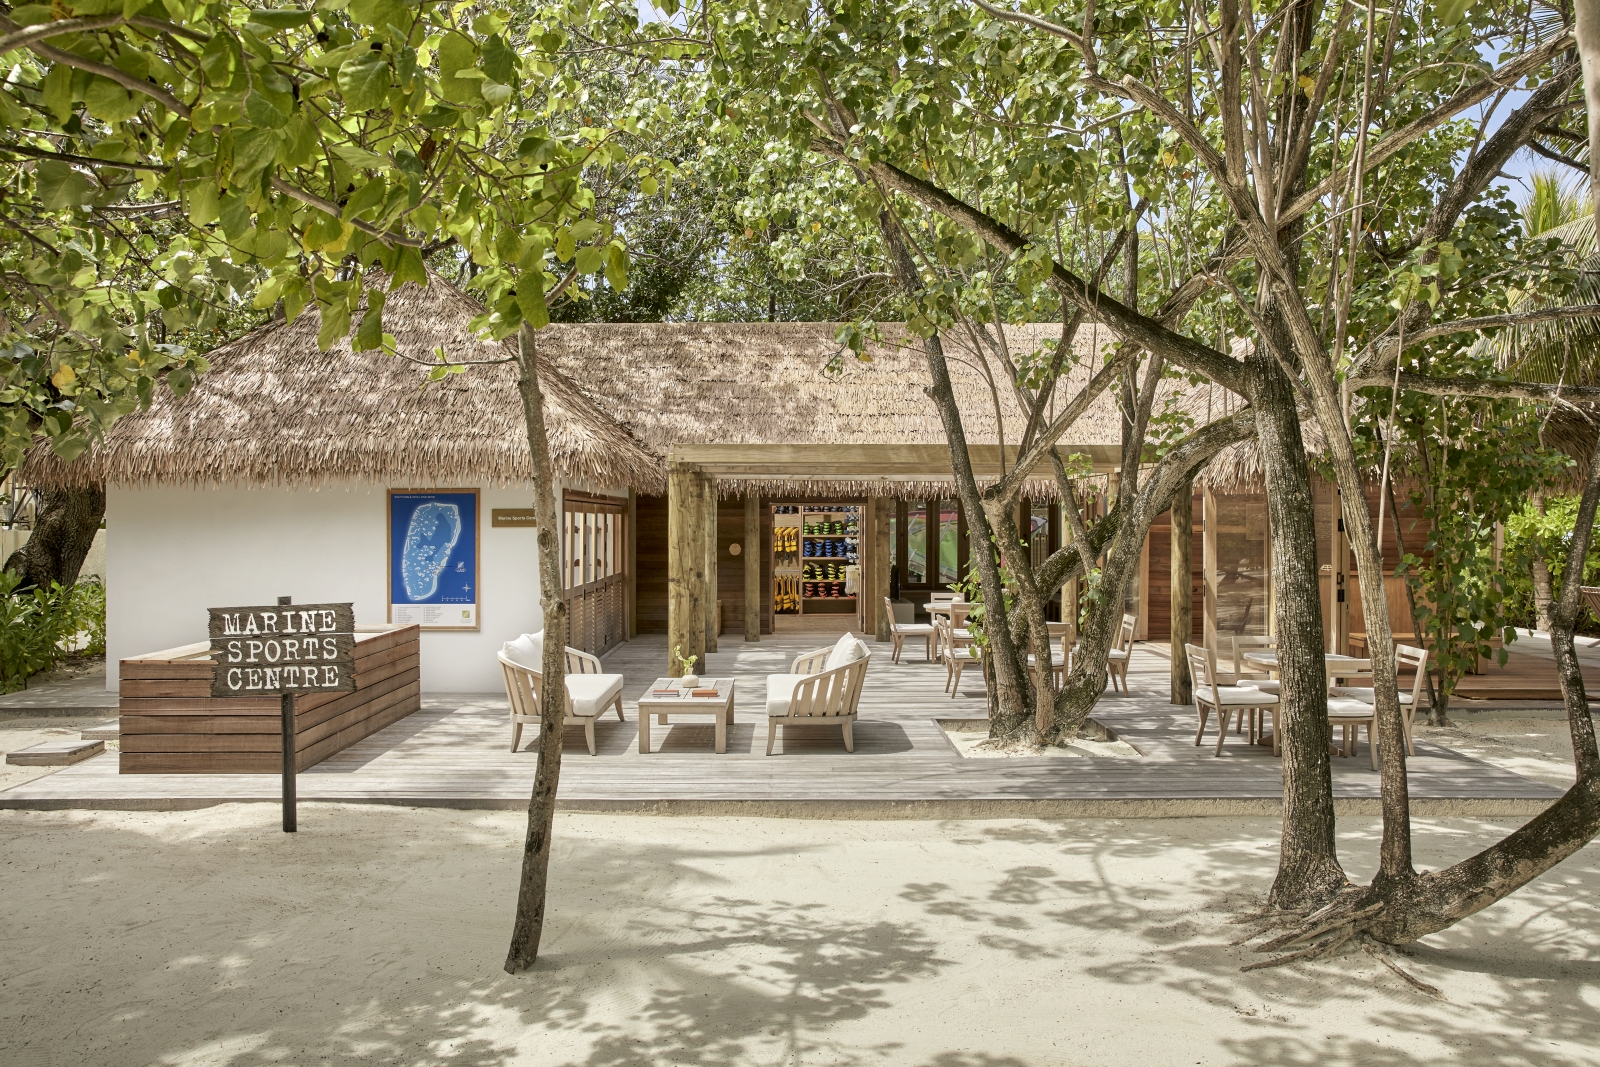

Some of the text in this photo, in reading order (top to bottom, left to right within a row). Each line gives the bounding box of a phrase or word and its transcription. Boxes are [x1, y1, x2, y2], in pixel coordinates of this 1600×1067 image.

[222, 610, 336, 635] MARINE
[228, 638, 337, 663] SPORTS
[227, 665, 339, 690] CENTRE
